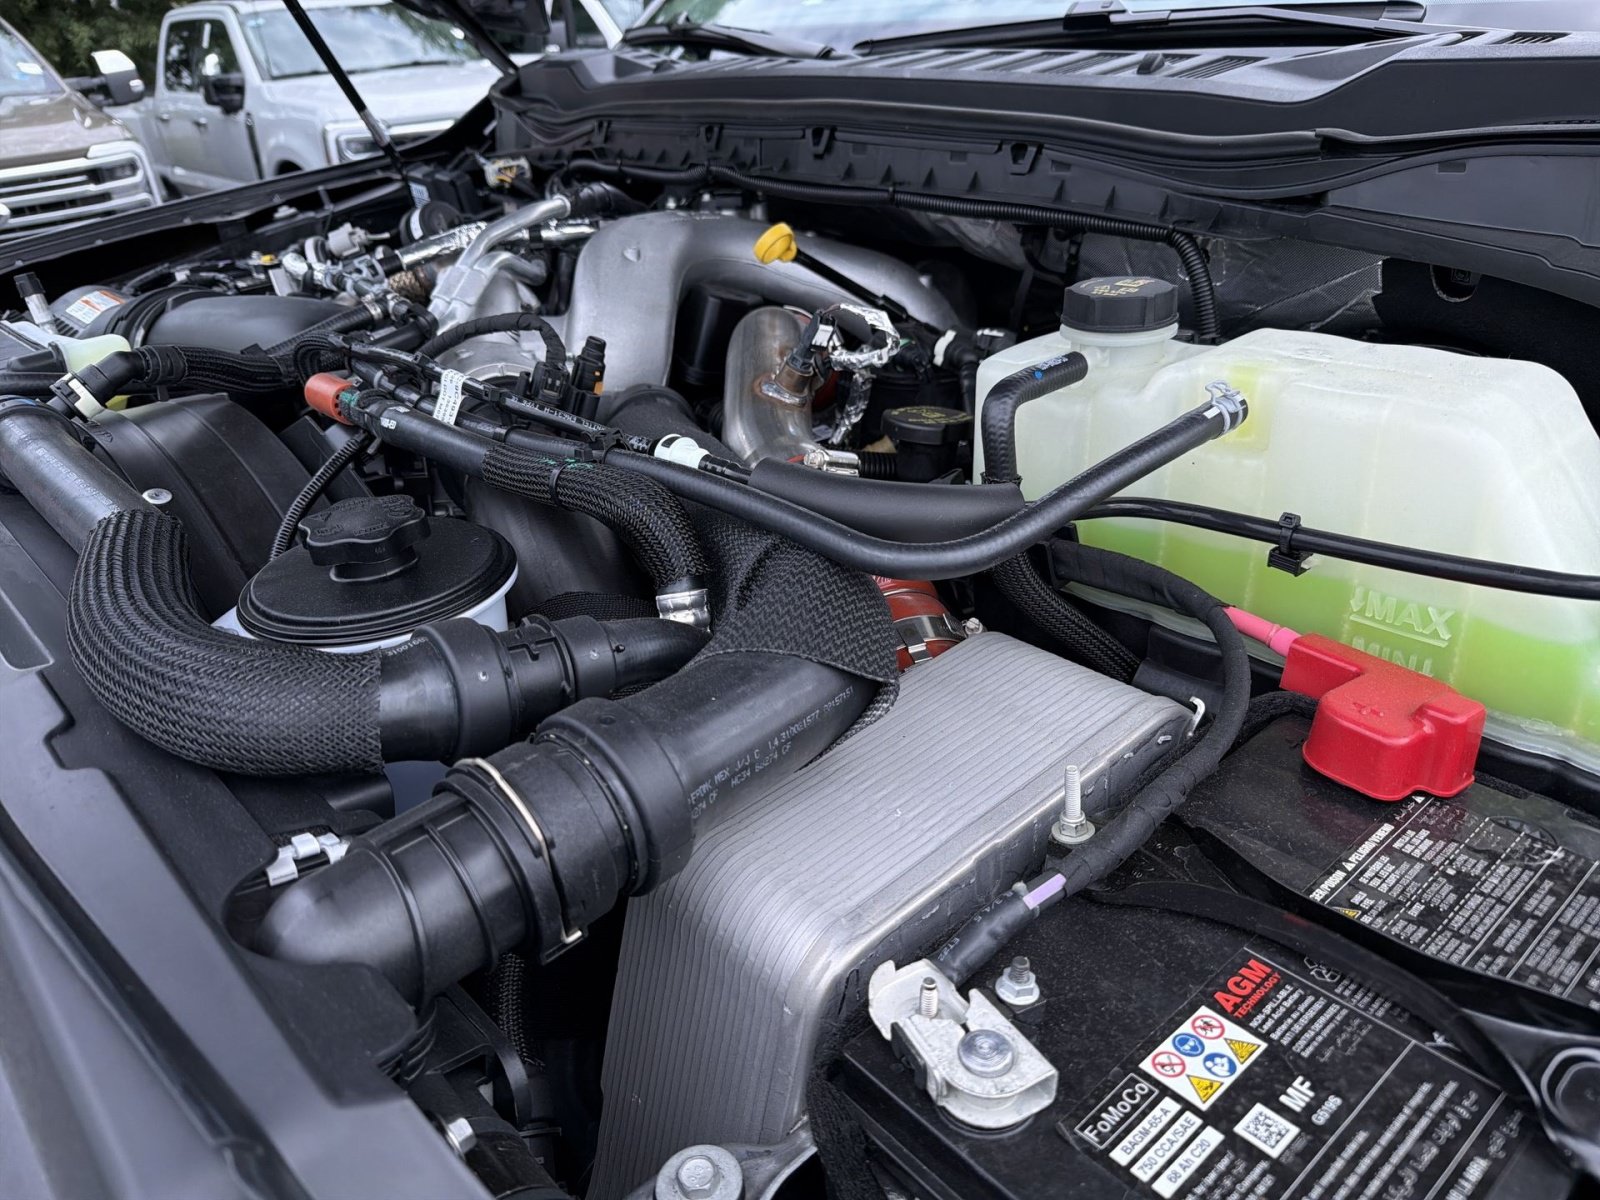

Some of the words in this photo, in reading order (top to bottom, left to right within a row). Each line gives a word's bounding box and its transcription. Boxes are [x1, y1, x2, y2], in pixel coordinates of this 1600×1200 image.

[1365, 591, 1455, 640] MAX
[1349, 823, 1395, 864] PELIGRO/VENENO
[1215, 960, 1271, 1012] AGM
[1234, 973, 1280, 1018] TECHNOLOGY
[1249, 985, 1293, 1028] NON-SPILLABLE
[1258, 1018, 1275, 1033] Lead
[1271, 1005, 1286, 1020] Acid
[1282, 988, 1305, 1008] Battery
[1270, 1018, 1294, 1040] Batterie
[1290, 1011, 1300, 1019] au
[1297, 995, 1315, 1013] plomb
[1292, 1030, 1316, 1052] CONTRA
[1311, 1004, 1340, 1032] DERRAMES
[1280, 1031, 1295, 1046] ANTI
[1084, 1083, 1149, 1142] FoMoCo
[1279, 1076, 1315, 1112] MF
[1312, 1095, 1342, 1125] G519S
[1121, 1108, 1171, 1155] BAGM-65-A
[1138, 1156, 1159, 1175] 750
[1154, 1117, 1196, 1158] CCA/SAE
[1167, 1170, 1182, 1184] 68
[1178, 1158, 1195, 1173] Ah
[1190, 1139, 1211, 1159] C20
